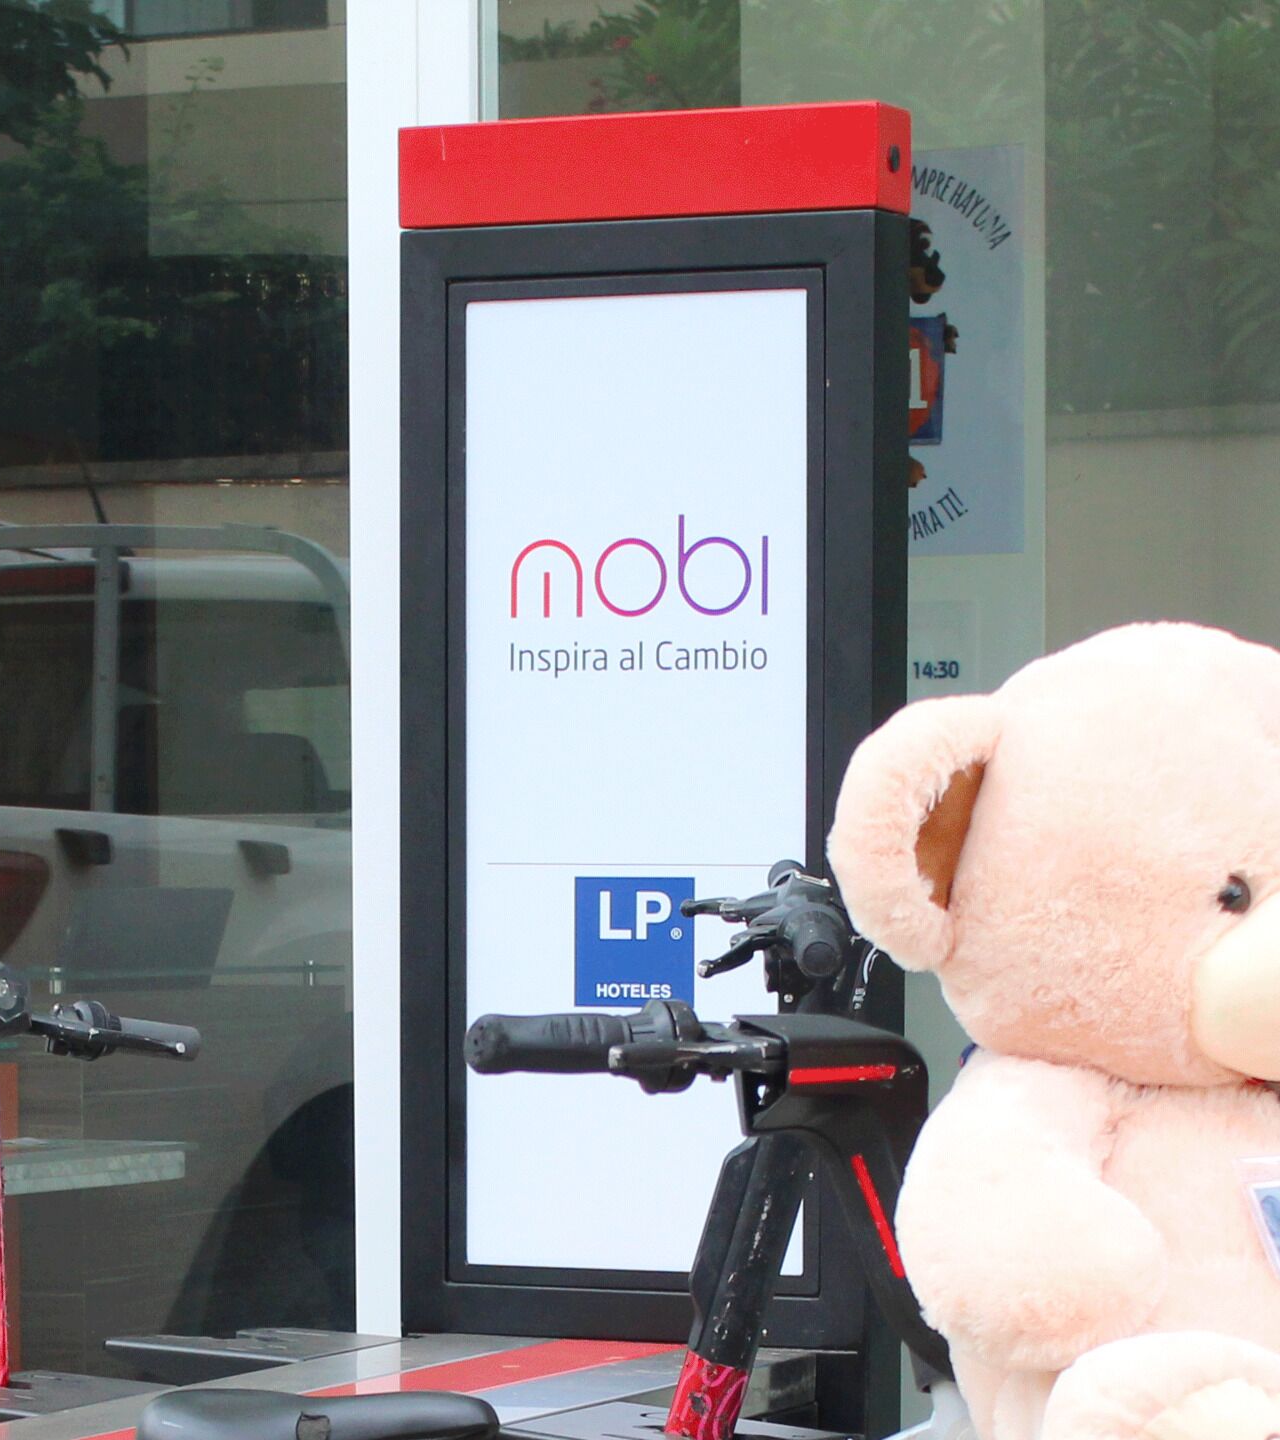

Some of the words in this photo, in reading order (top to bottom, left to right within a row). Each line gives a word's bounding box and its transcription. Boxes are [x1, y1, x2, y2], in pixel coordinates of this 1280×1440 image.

[948, 181, 984, 218] HAY
[908, 505, 945, 541] ARA
[936, 487, 969, 522] TI!
[511, 514, 768, 618] mobi
[510, 641, 608, 679] Inspira
[619, 640, 643, 671] al
[656, 640, 768, 671] Cambio
[913, 661, 959, 679] 14:30
[596, 983, 672, 999] HOTELES
